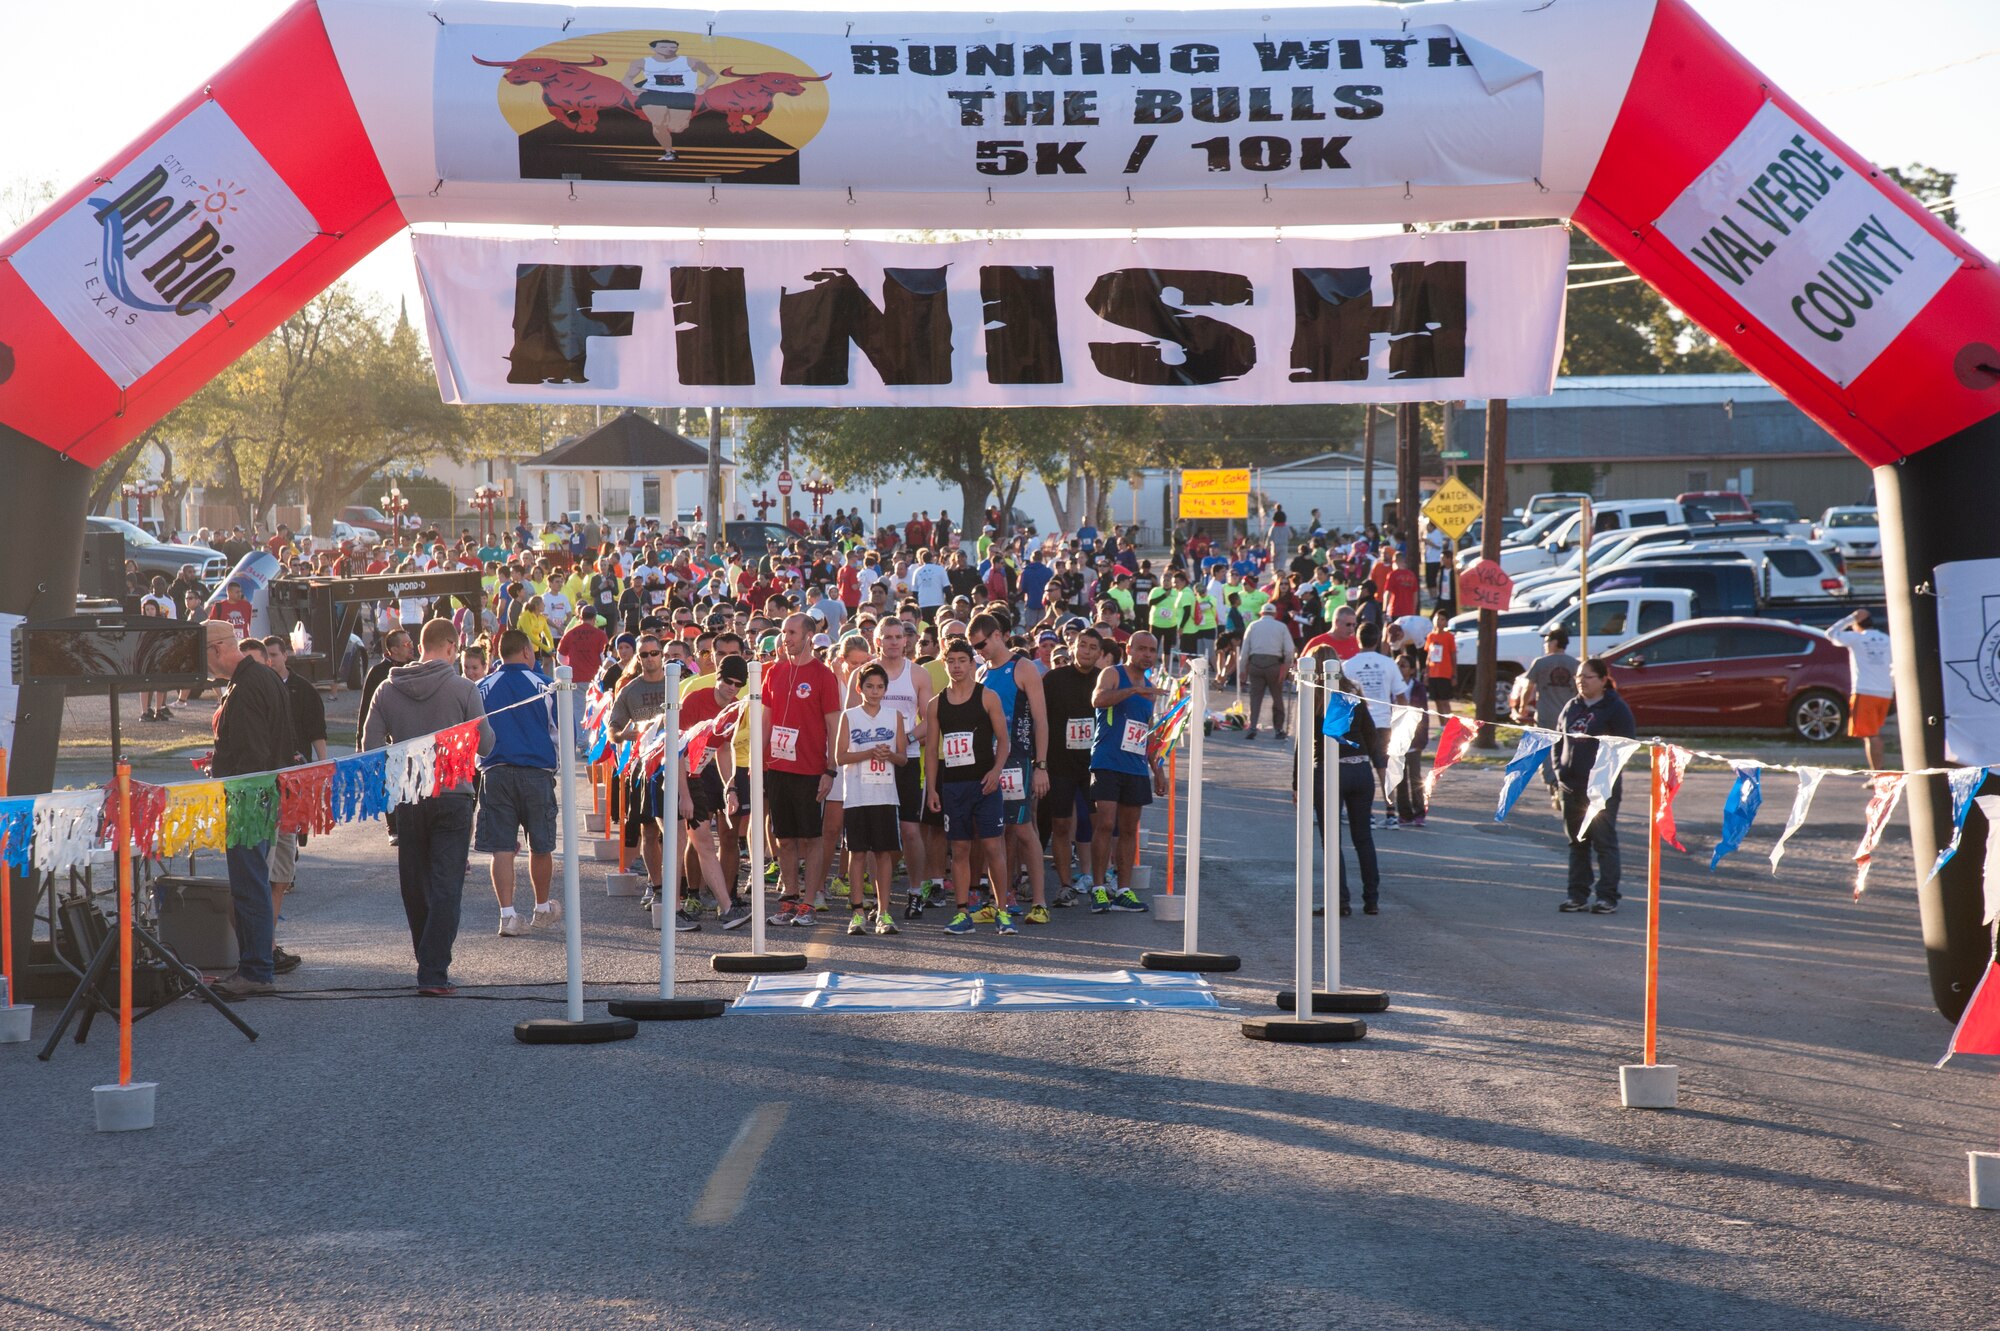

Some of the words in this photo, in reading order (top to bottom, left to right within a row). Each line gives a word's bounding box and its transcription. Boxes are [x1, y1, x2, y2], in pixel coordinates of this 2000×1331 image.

[849, 39, 1221, 76] RUNNING
[1252, 37, 1474, 72] WITH
[947, 85, 1101, 127] THE
[1133, 83, 1385, 125] BULLS
[164, 154, 185, 175] CITY
[181, 175, 197, 189] OF
[976, 139, 1087, 176] 5K
[1122, 134, 1159, 174] /
[1191, 135, 1352, 173] 10K
[93, 164, 197, 261] Del
[1690, 215, 1777, 287] VAL
[1737, 134, 1845, 236] VERDE
[141, 220, 236, 317] Rio
[1791, 214, 1915, 343] COUNTY
[84, 257, 139, 326] TEXAS
[502, 261, 1467, 386] FINISH
[1184, 477, 1219, 489] Funnel
[1223, 473, 1249, 484] Cake
[1439, 491, 1468, 500] WATCH
[1436, 504, 1475, 515] CHILDREN
[1443, 516, 1466, 526] AREA
[1473, 586, 1501, 605] SALE
[777, 733, 790, 749] 77
[850, 728, 872, 739] Del
[875, 727, 895, 739] Rio
[947, 738, 968, 756] 115
[1070, 725, 1092, 739] 116
